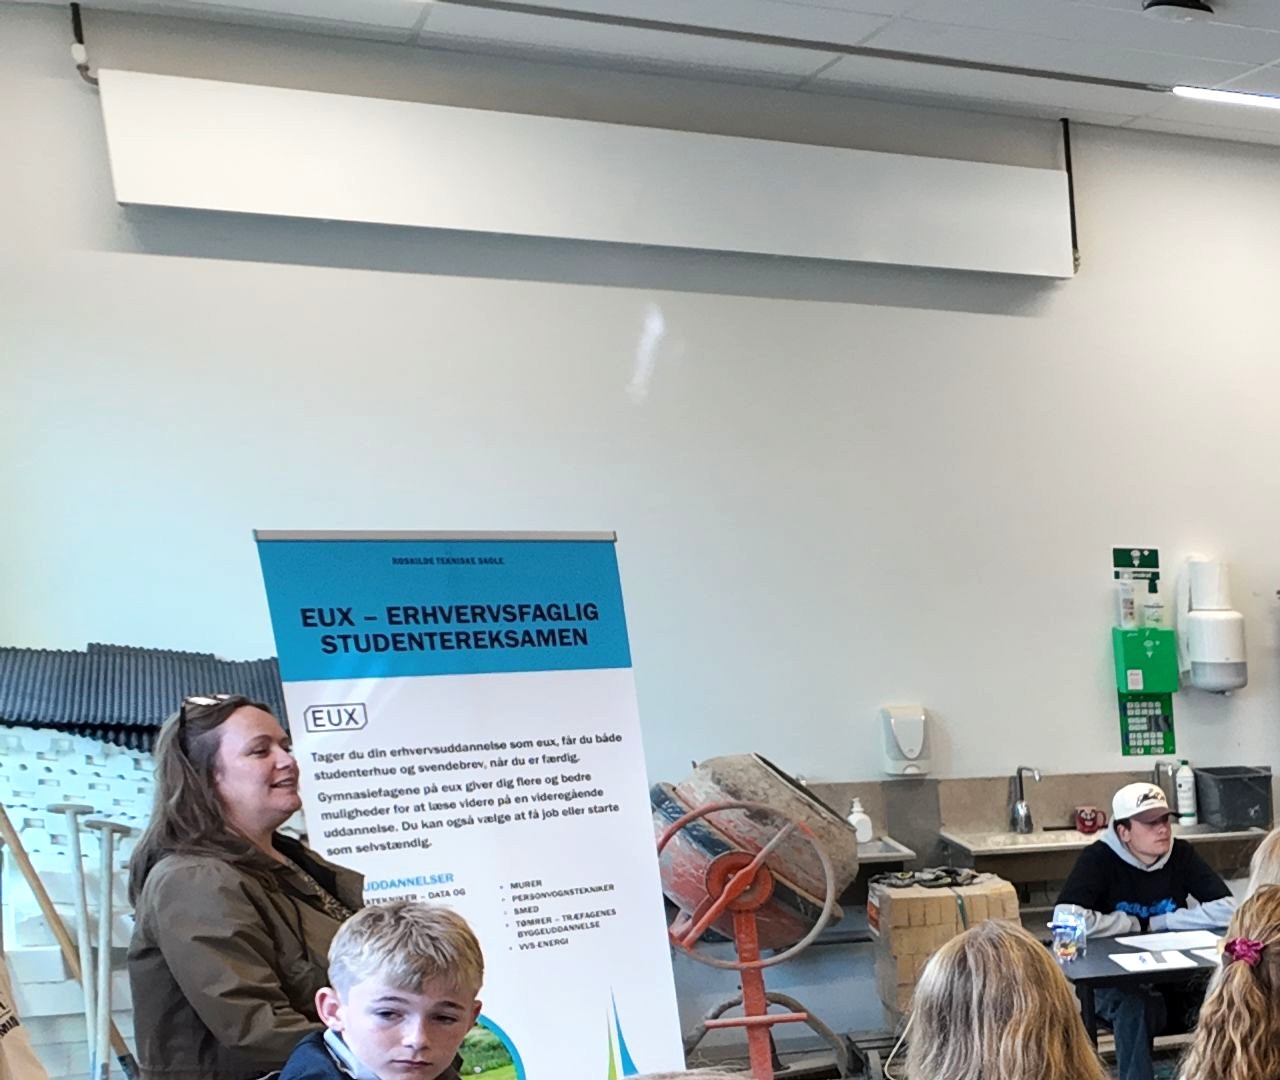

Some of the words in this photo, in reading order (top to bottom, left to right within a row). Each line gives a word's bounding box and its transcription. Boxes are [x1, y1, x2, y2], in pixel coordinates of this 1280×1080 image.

[392, 556, 434, 565] ROSKILDE
[436, 556, 477, 565] TEKNISKE
[478, 557, 505, 565] SKOLE
[300, 607, 355, 627] EUX
[386, 602, 599, 625] ERHVERVSFAGLIG
[321, 628, 589, 654] STUDENTEREKSAMEN
[312, 707, 359, 728] EUX
[311, 751, 345, 764] Tager
[349, 750, 364, 760] du
[367, 749, 387, 759] din
[390, 741, 507, 757] erhvervsuddannelse
[510, 740, 533, 749] som
[536, 739, 560, 748] eux,
[561, 735, 577, 745] får
[579, 735, 593, 745] du
[595, 733, 622, 743] både
[314, 767, 397, 780] studenterhue
[399, 765, 416, 776] og
[418, 760, 487, 773] svendebrev,
[490, 757, 508, 768] når
[511, 756, 525, 766] du
[528, 757, 539, 765] er
[542, 752, 580, 764] færdig.
[317, 786, 421, 804] Gymnasiefagene
[423, 782, 438, 795] på
[441, 783, 462, 793] eux
[465, 780, 493, 793] giver
[496, 778, 514, 790] dig
[516, 776, 542, 786] flere
[544, 774, 559, 786] og
[561, 772, 591, 783] bedre
[321, 806, 391, 821] muligheder
[393, 804, 410, 814] for
[413, 803, 425, 813] at
[428, 801, 457, 812] læse
[459, 797, 494, 809] videre
[497, 795, 511, 807] på
[514, 795, 529, 804] en
[530, 788, 604, 802] videregående
[324, 825, 399, 838] uddannelse.
[401, 820, 418, 831] Du
[421, 818, 443, 830] kan
[446, 815, 475, 829] også
[477, 812, 511, 824] vælge
[514, 811, 526, 821] at
[528, 808, 540, 819] få
[541, 808, 559, 821] job
[561, 806, 585, 816] eller
[588, 803, 620, 814] starte
[327, 846, 352, 857] som
[355, 837, 432, 855] selvstændig.
[428, 889, 451, 900] DATA
[453, 887, 466, 896] OG
[510, 880, 542, 889] MURER
[512, 884, 615, 902] PERSONVOGNSTEKNIKER
[513, 906, 539, 915] SMED
[515, 917, 552, 927] TØMRER
[561, 908, 617, 922] TRÆFAGENES
[517, 921, 600, 938] BYGGEUDDANNELSE
[519, 938, 569, 950] VVS-ENERGI
